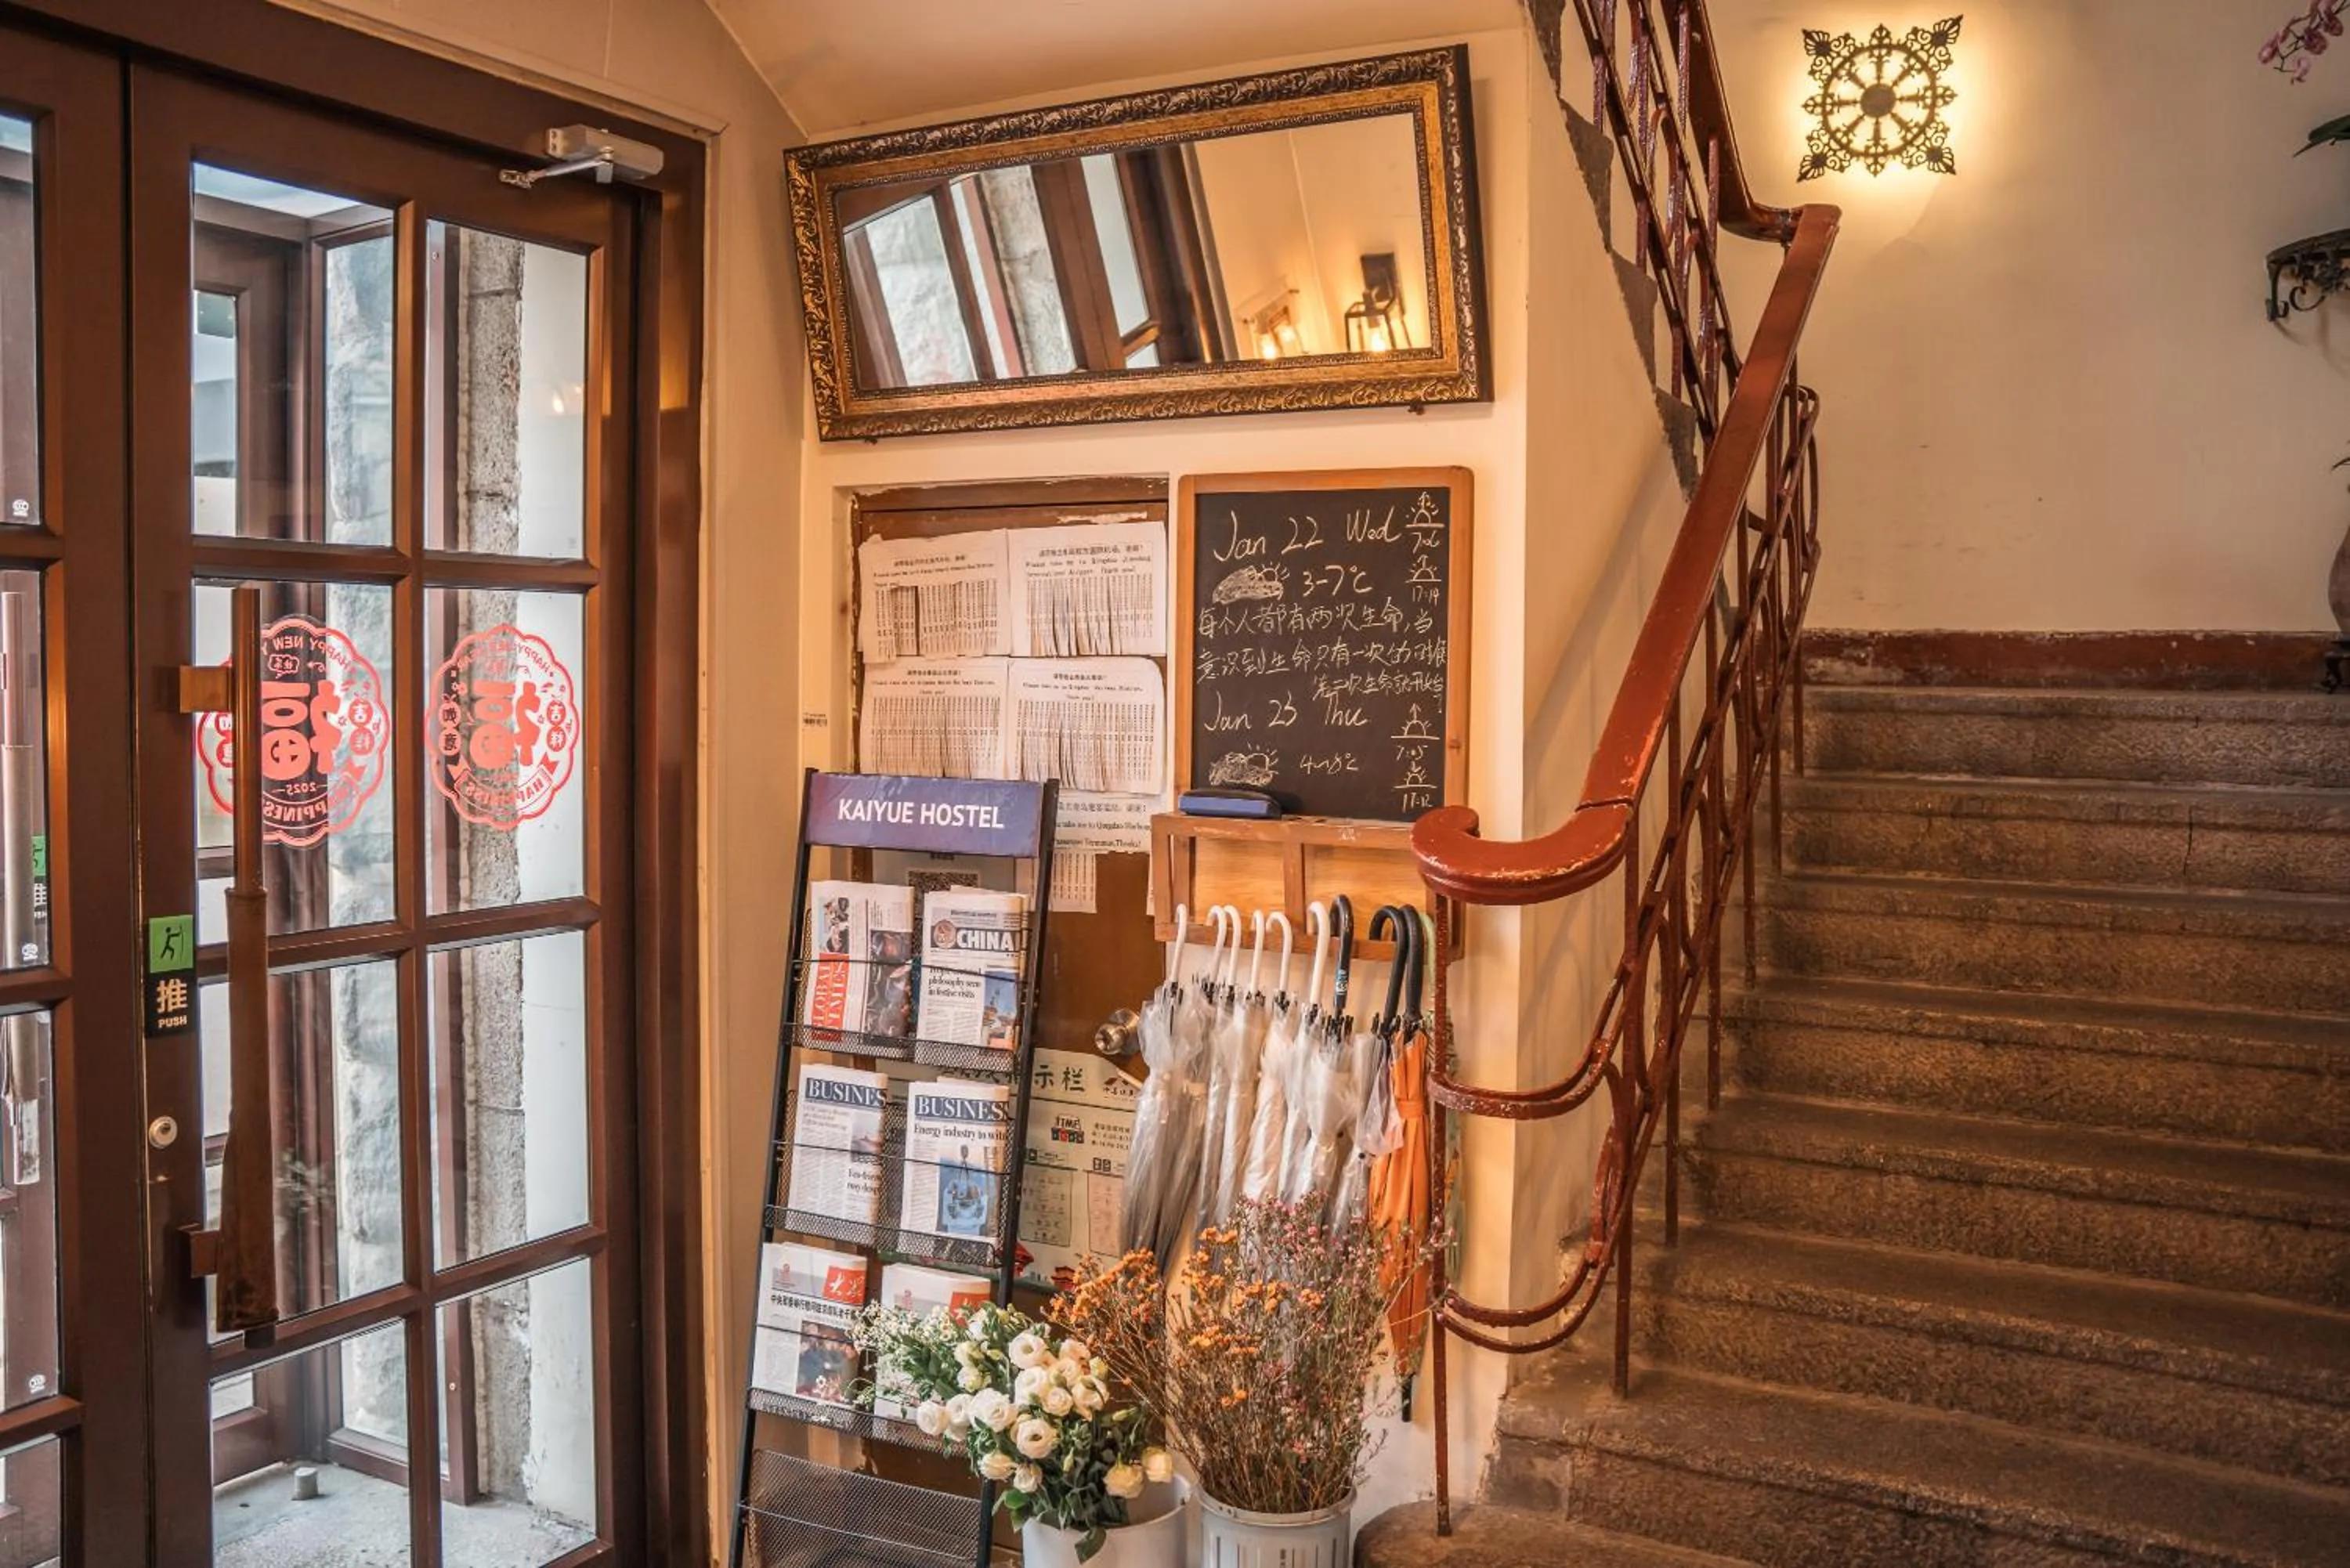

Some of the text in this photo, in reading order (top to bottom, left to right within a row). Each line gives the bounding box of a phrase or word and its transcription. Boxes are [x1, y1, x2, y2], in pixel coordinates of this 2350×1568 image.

[1213, 506, 1401, 562] Jan 22 Wed
[1204, 690, 1252, 731] Jan
[838, 798, 1005, 828] KAIYUE HOSTEL
[956, 929, 1015, 951] CHINA
[157, 978, 188, 1013] 推
[158, 1015, 187, 1028] PUSH
[914, 1124, 940, 1137] Energy
[943, 1126, 975, 1141] industry
